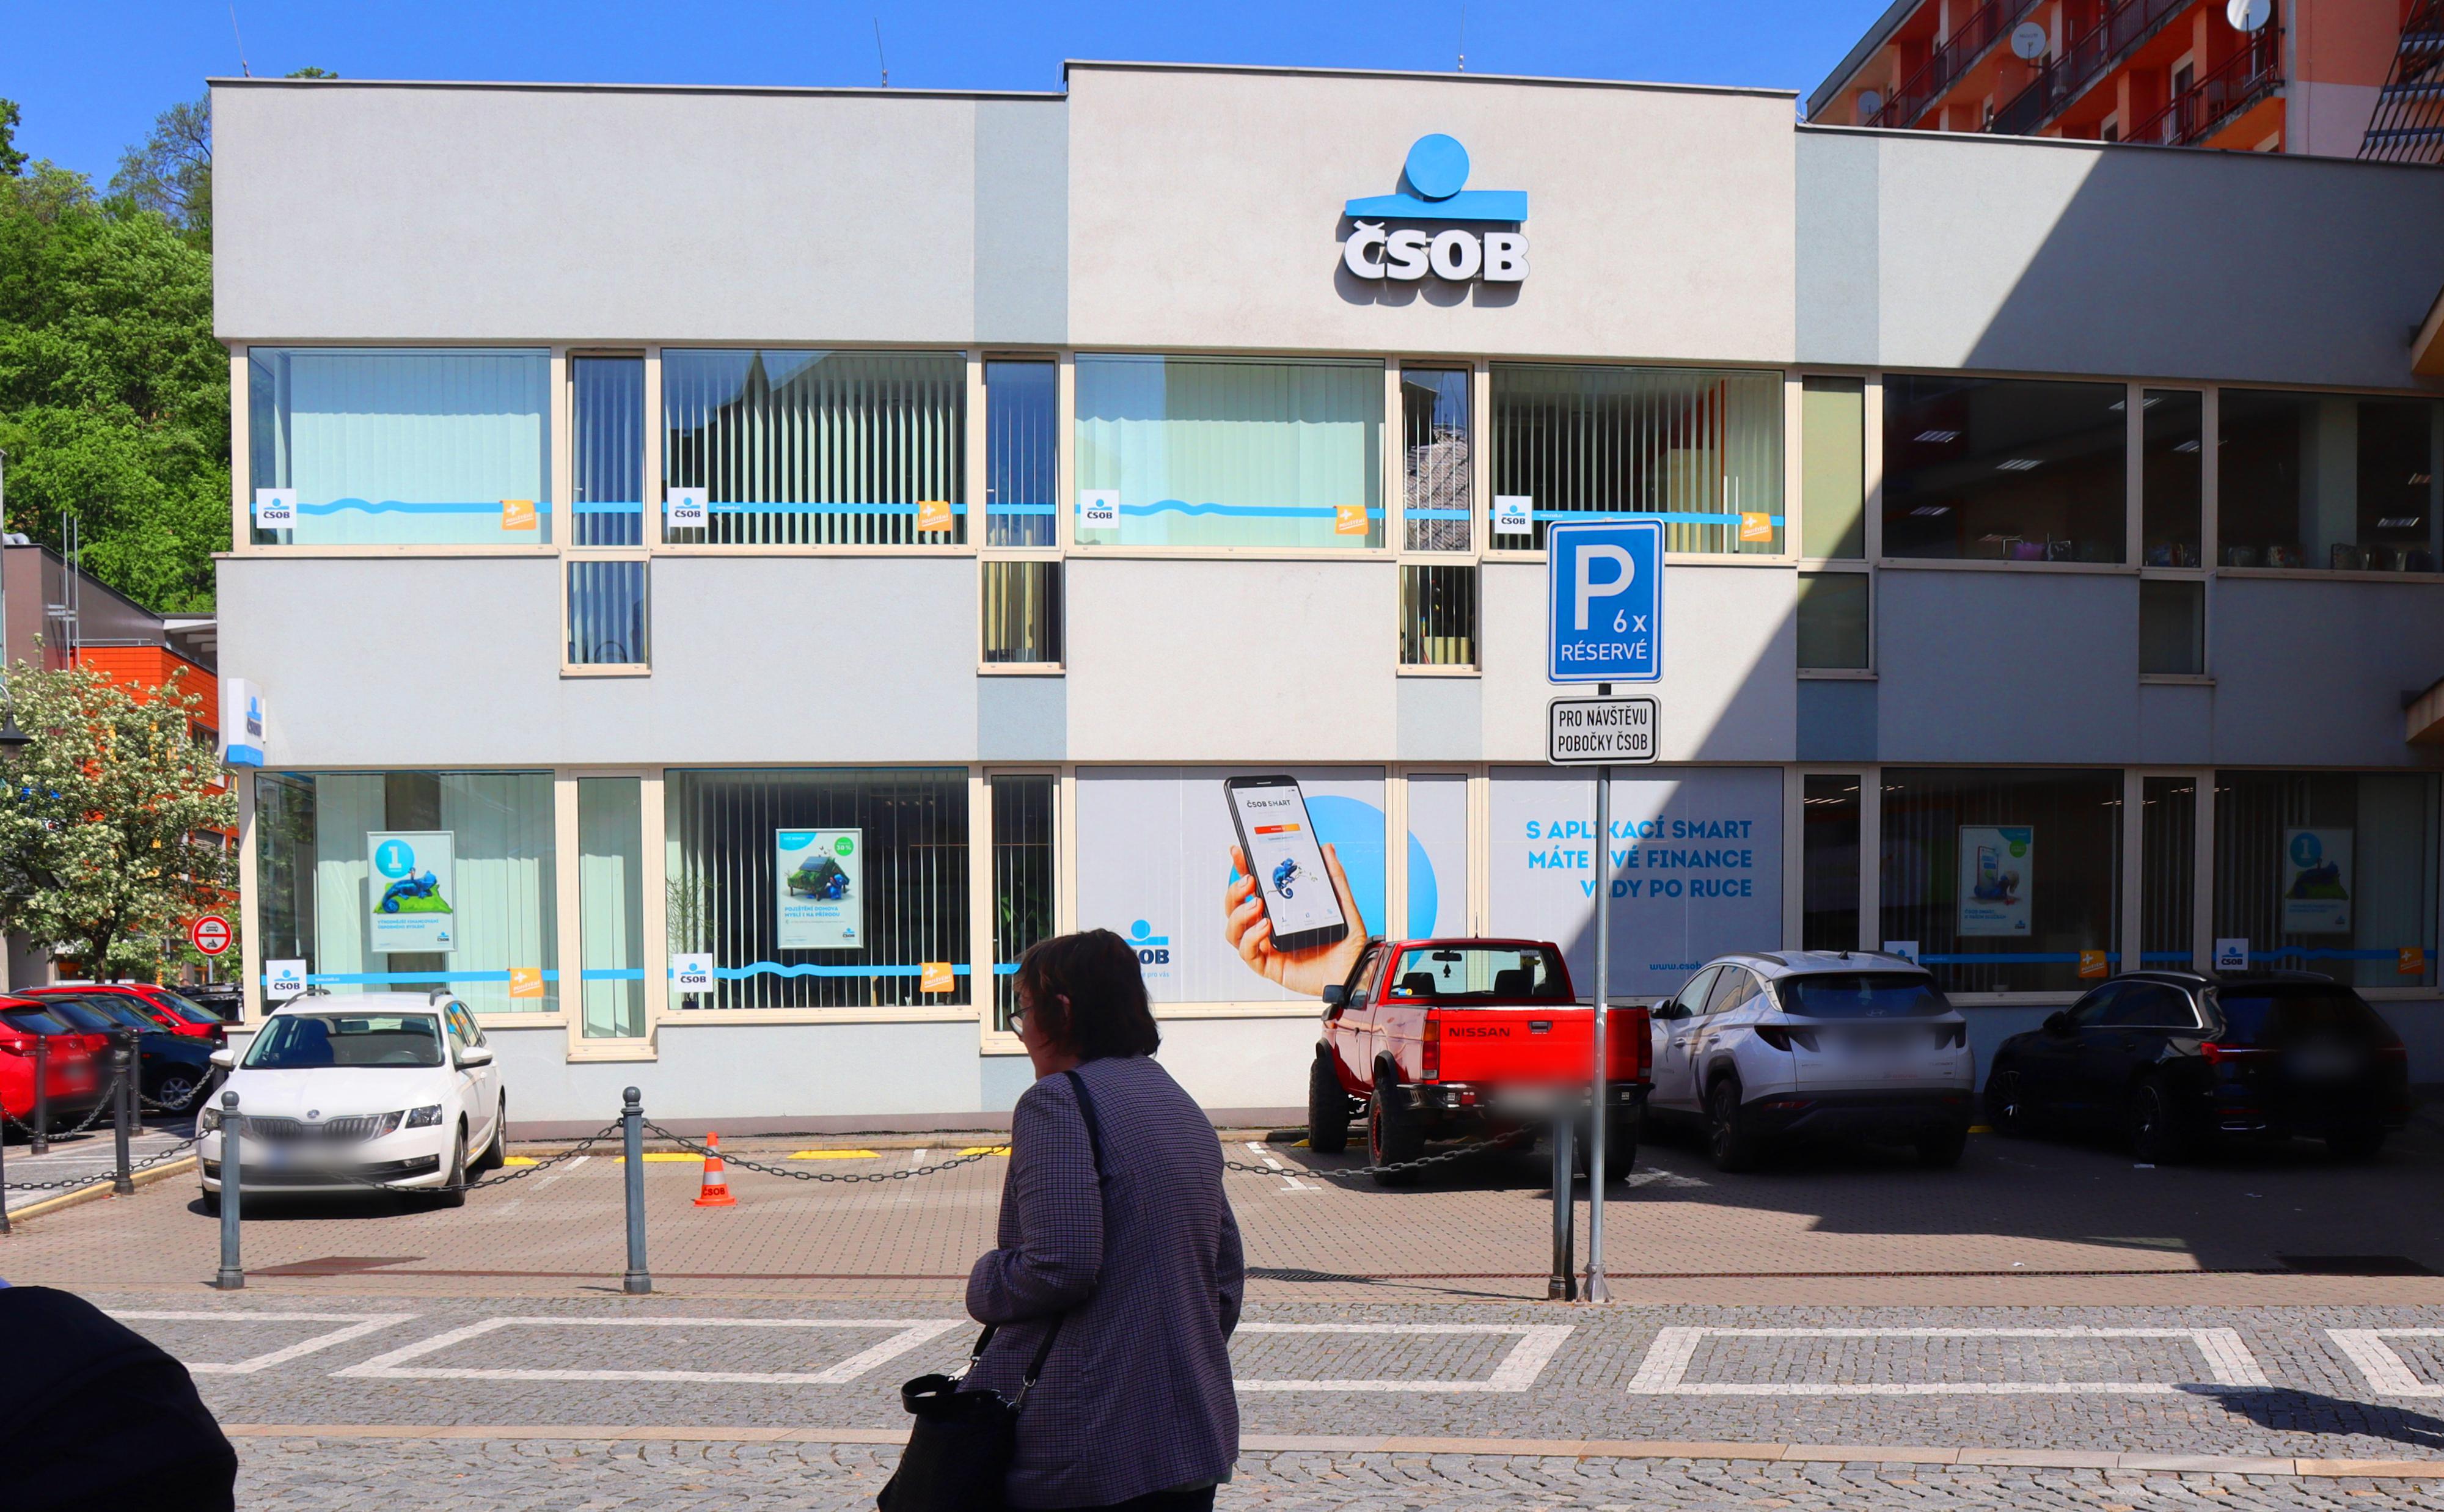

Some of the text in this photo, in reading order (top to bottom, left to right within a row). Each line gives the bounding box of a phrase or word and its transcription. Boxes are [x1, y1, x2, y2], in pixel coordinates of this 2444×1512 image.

[1344, 220, 1530, 281] ČSOB
[263, 510, 290, 519] ČSOB
[674, 509, 701, 518] ČSOB
[1087, 510, 1113, 519] ČSOB
[1575, 544, 1635, 630] P
[1562, 638, 1647, 661] RÉSERVÉ
[1559, 706, 1647, 727] PRO NÁVŠTĚVU
[1559, 729, 1648, 752] POBOČKY ČSOB
[1246, 800, 1267, 808] ČSOB
[1526, 820, 1541, 839] S
[1672, 820, 1752, 839] SMART
[388, 846, 402, 869] 1
[1529, 845, 1752, 869] MÁTE VÉ FINANCE
[2300, 839, 2311, 858] 1
[1581, 878, 1752, 898] VDY PO RUCE
[2221, 957, 2243, 966] ČSOB
[274, 982, 300, 990] ČSOB
[680, 975, 706, 984] ČSOB
[1449, 1028, 1510, 1037] NISSAN
